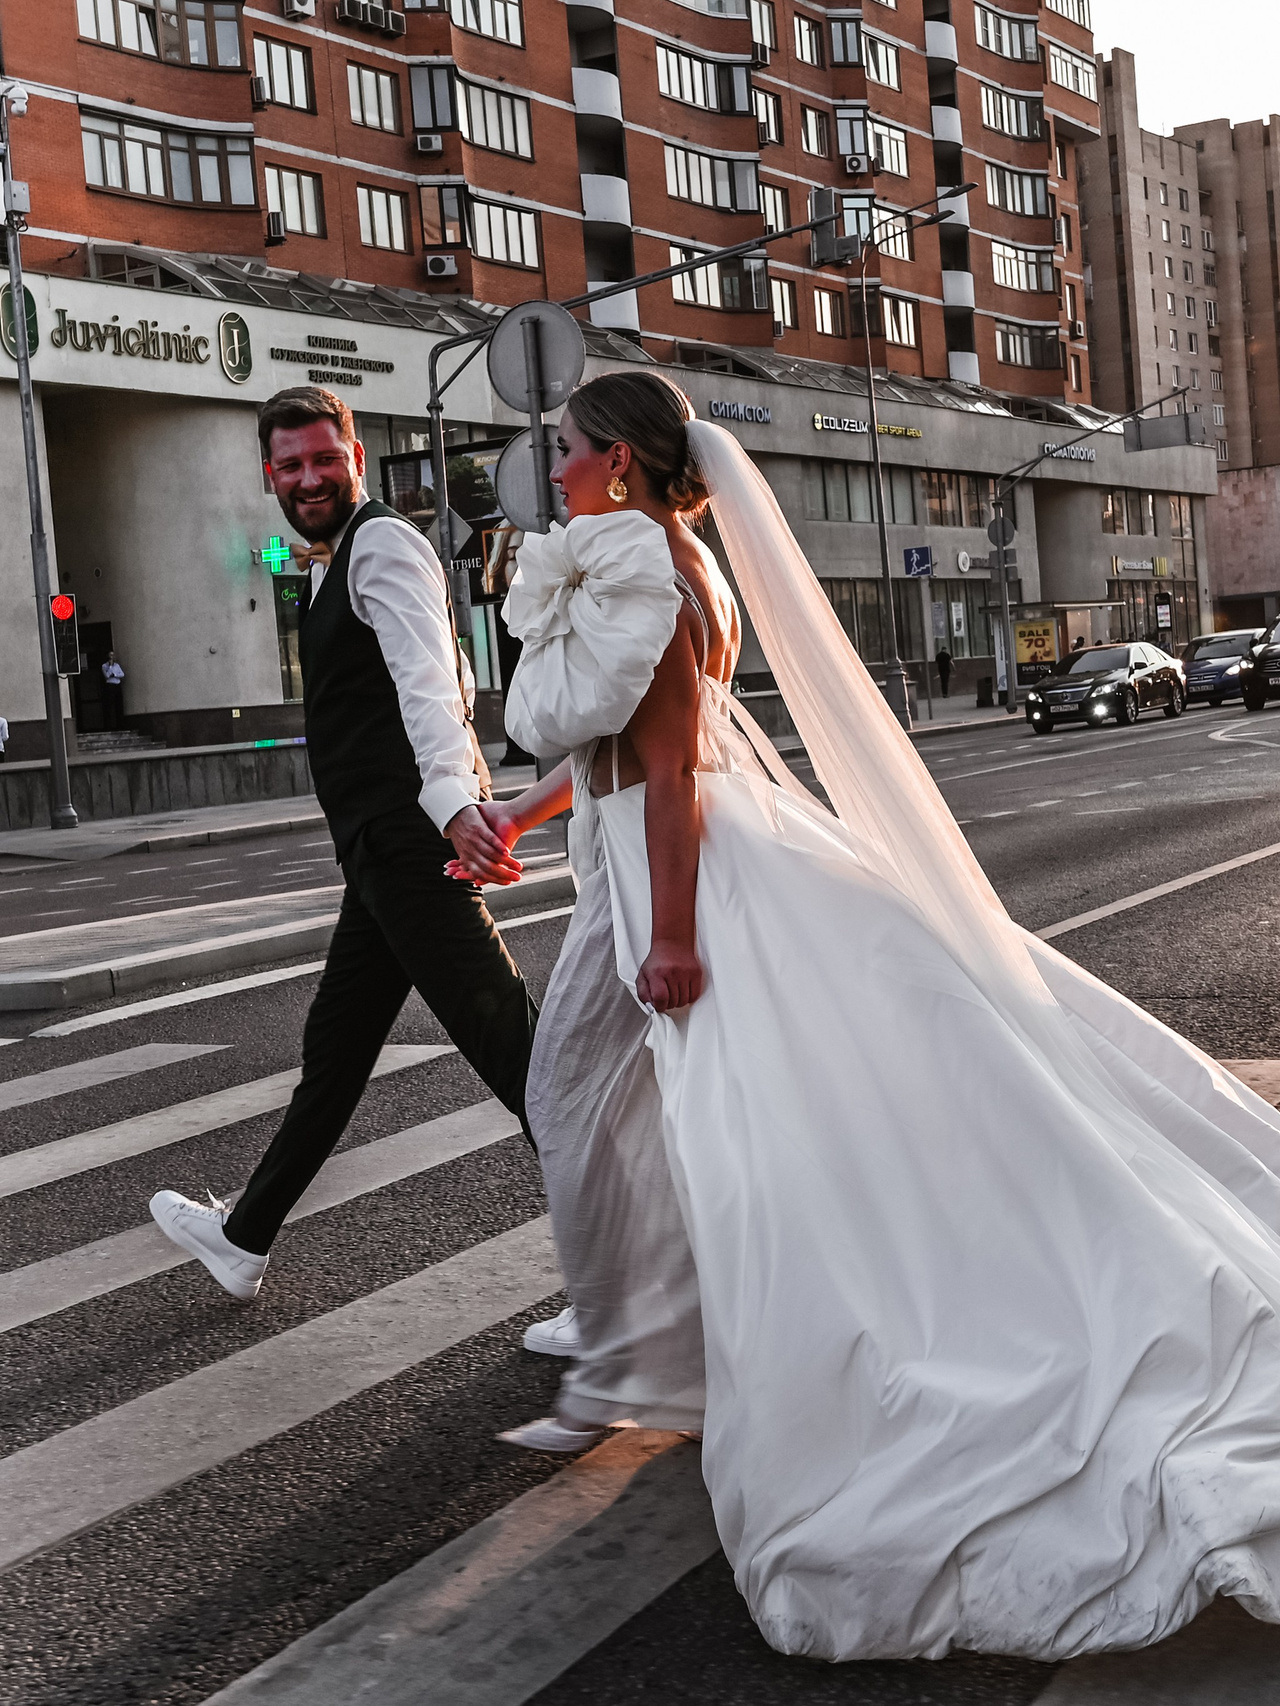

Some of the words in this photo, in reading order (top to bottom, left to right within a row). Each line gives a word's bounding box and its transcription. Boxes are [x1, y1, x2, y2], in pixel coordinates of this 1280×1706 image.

[51, 308, 212, 364] Juviclinic
[307, 335, 358, 352] КЛИНИКА
[270, 347, 330, 367] МУЖСКОГО
[331, 355, 340, 366] И
[341, 356, 395, 374] ЖЕНСКОГО
[308, 369, 363, 386] ЗДОРОВЬЯ
[822, 416, 869, 433] COLIZEUM
[889, 426, 905, 436] SPORT
[907, 428, 922, 438] ARENA
[451, 557, 482, 570] ТВИЕ
[1018, 629, 1050, 638] SALE
